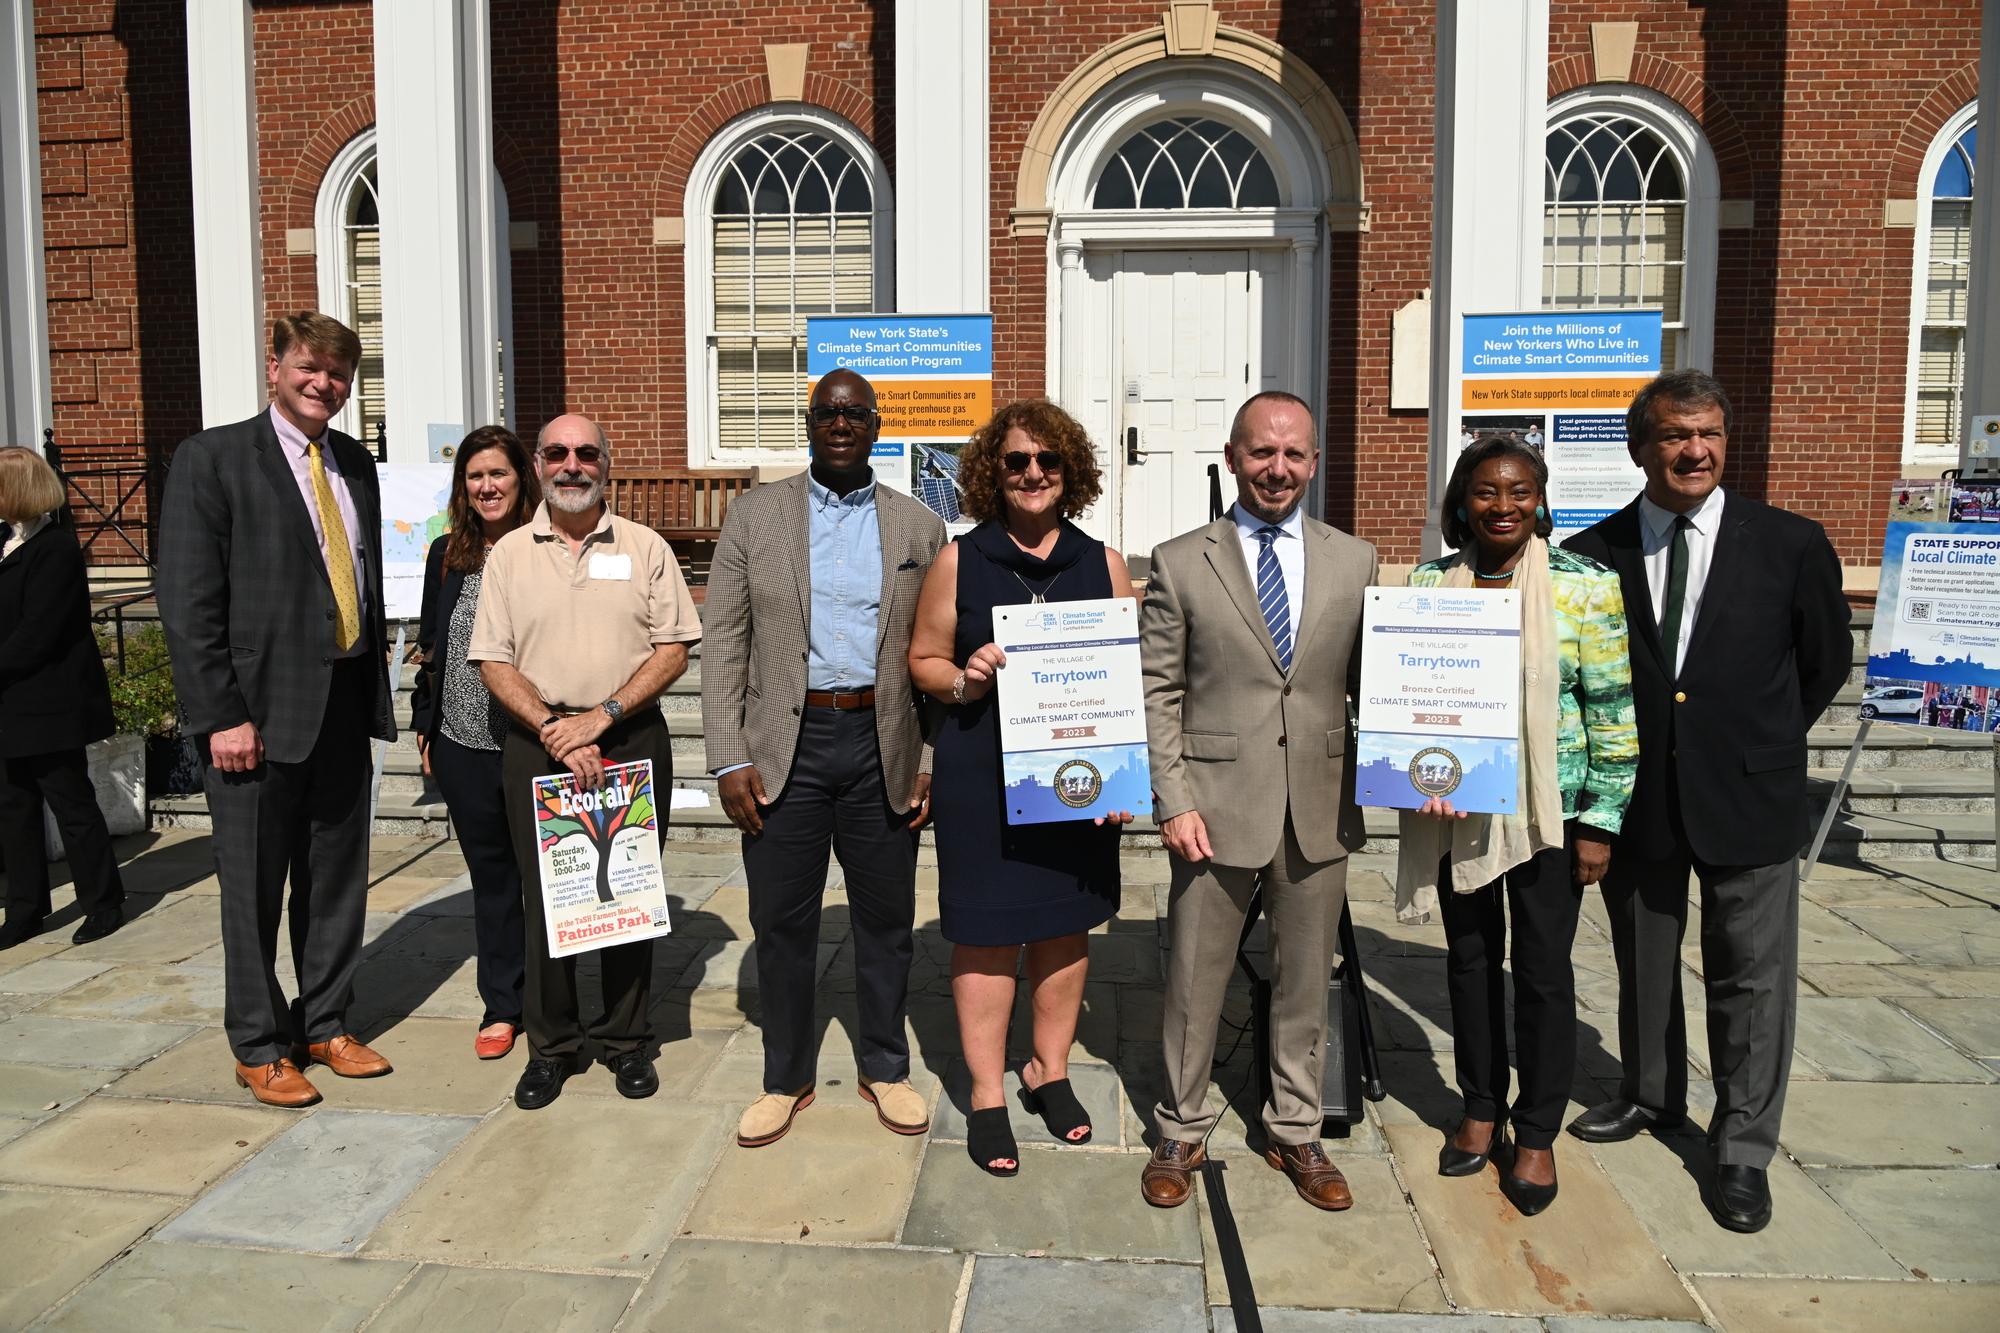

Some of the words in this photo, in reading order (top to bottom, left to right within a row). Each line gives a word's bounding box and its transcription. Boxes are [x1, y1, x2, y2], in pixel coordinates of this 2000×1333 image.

[850, 328, 876, 338] New
[879, 328, 905, 338] York
[908, 327, 948, 338] State's
[1502, 325, 1529, 336] Join
[1532, 325, 1553, 335] the
[1556, 324, 1605, 335] Millions
[1608, 324, 1621, 334] of
[817, 343, 862, 353] Climate
[865, 342, 900, 352] Smart
[903, 341, 981, 352] Communities
[1484, 340, 1512, 350] New
[1516, 339, 1563, 350] Yorkers
[1566, 339, 1595, 349] Who
[1599, 338, 1624, 349] Live
[1627, 338, 1639, 348] in
[836, 357, 908, 367] Certification
[911, 356, 962, 368] Program
[1473, 354, 1521, 365] Climate
[1525, 354, 1562, 364] Smart
[1566, 353, 1649, 364] Communities
[888, 391, 910, 400] Smart
[913, 391, 961, 400] Communities
[1472, 390, 1488, 400] New
[1491, 390, 1509, 399] York
[1511, 389, 1532, 399] State
[1534, 390, 1568, 400] supports
[1570, 389, 1589, 398] local
[1591, 388, 1620, 398] climate
[878, 405, 906, 415] educing
[908, 404, 950, 414] greenhouse
[953, 405, 966, 414] gas
[909, 418, 936, 426] climate
[939, 417, 976, 426] resilience.
[1914, 539, 1950, 548] STATE
[1911, 550, 1944, 563] Local
[1947, 550, 1996, 565] Climate
[1063, 617, 1104, 625] Communities
[1057, 656, 1084, 664] VILLAGE
[1398, 653, 1480, 670] Tarrytown
[1032, 669, 1107, 685] Tarrytown
[1402, 684, 1433, 693] Bronze
[1436, 686, 1475, 695] Certified
[1039, 702, 1068, 710] Bronze
[1070, 698, 1105, 708] Certified
[1369, 697, 1409, 706] CLIMATE
[1412, 699, 1444, 708] SMART
[1447, 700, 1508, 710] COMMUNITY
[1010, 716, 1047, 725] CLIMATE
[1049, 713, 1079, 722] SMART
[1081, 709, 1135, 720] COMMUNITY
[1425, 715, 1450, 724] 2023
[1063, 728, 1086, 737] 2023
[552, 845, 588, 858] Saturday,
[553, 858, 568, 867] Oct.
[569, 856, 577, 865] 14
[554, 862, 591, 877] 10:00-2:00
[612, 867, 636, 876] VENDORS,
[638, 863, 656, 871] DEMOS,
[548, 880, 576, 889] GIVEAWAYS,
[610, 873, 645, 884] ENERGY-SAVING
[557, 884, 589, 895] SUSTAINABLE
[616, 887, 642, 897] RECYCLING
[644, 883, 658, 891] IDEAS
[553, 893, 580, 902] PRODUCTS,
[553, 902, 566, 910] FREE
[569, 897, 594, 906] ACTIVITIES
[564, 920, 575, 928] the
[575, 915, 592, 925] TaSH
[593, 910, 617, 921] Farmers
[618, 906, 641, 916] Market,
[558, 924, 615, 943] Patriots
[617, 912, 652, 930] Park
